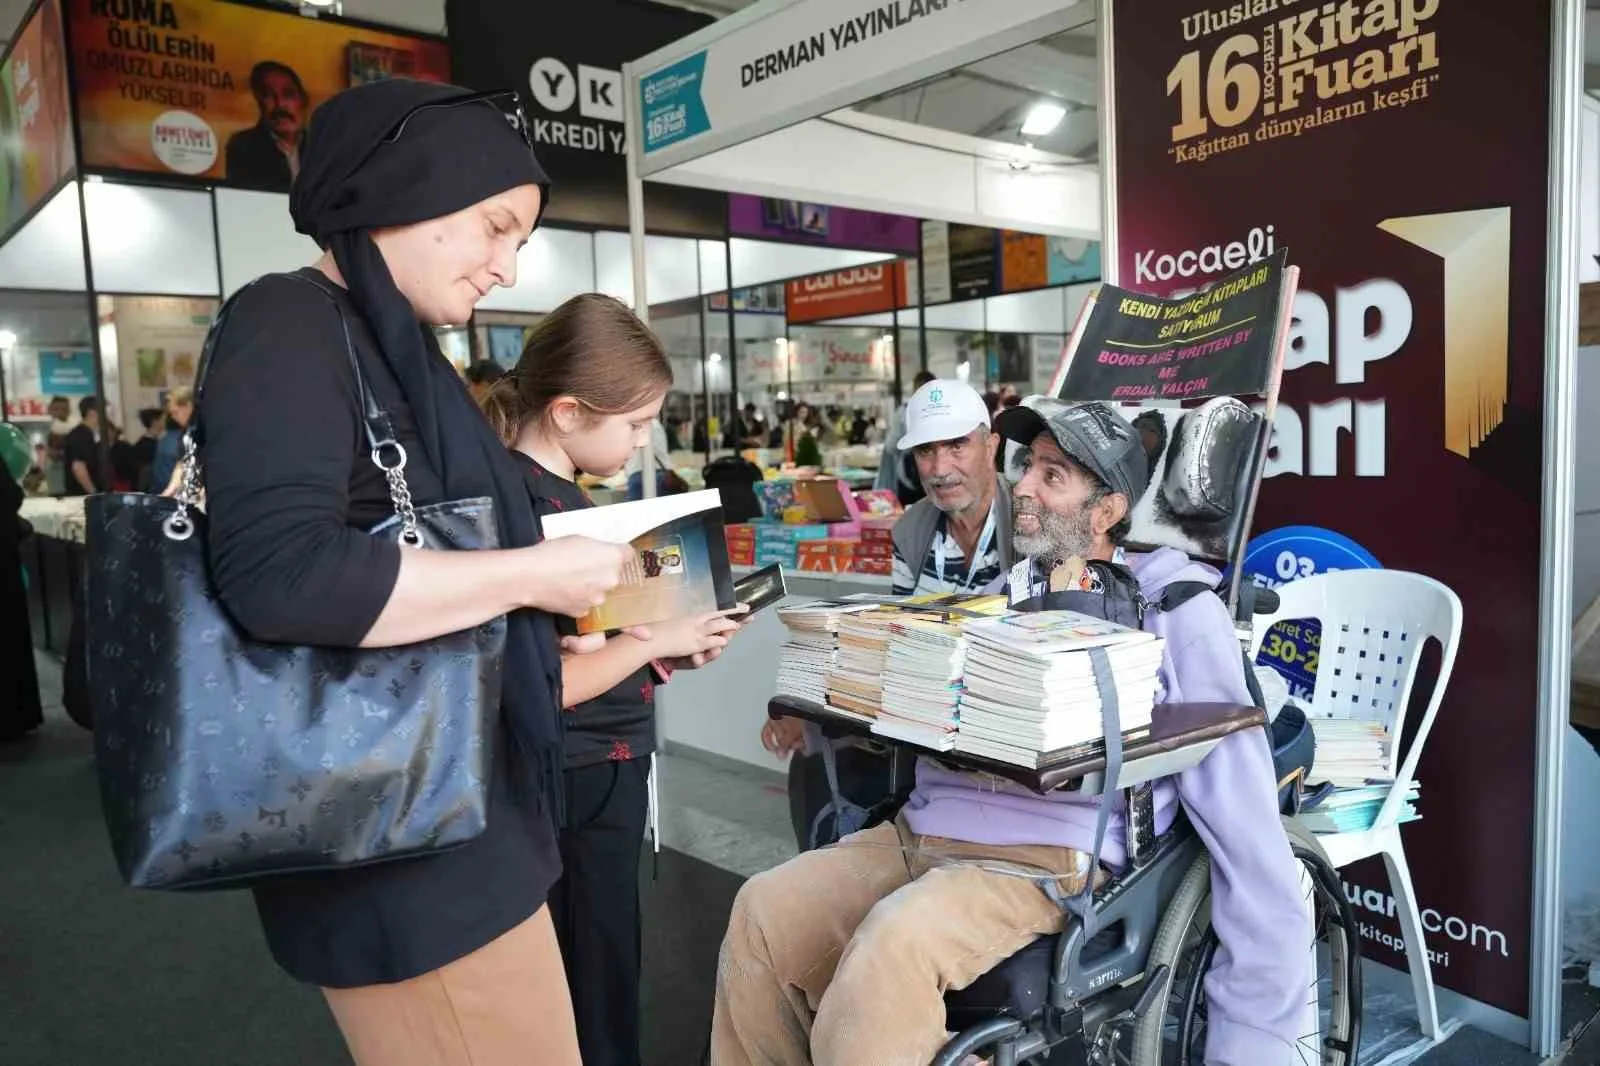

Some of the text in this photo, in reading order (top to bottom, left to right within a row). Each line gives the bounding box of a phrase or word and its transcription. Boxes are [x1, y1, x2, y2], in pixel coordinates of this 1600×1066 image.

[107, 20, 215, 63] ÖLÜLERİN
[1279, 0, 1440, 64] Kitap
[86, 51, 234, 90] OMUZLARINDA
[741, 32, 825, 88] DERMAN
[1279, 32, 1440, 112] Fuarı
[541, 70, 565, 97] Y
[590, 79, 614, 107] K
[534, 118, 604, 152] KREDİ
[1256, 99, 1366, 141] dünyaların
[1135, 225, 1275, 284] Kocaeli
[1118, 297, 1163, 320] KENDİ
[1097, 328, 1254, 366] BOOKS ARE WRITTEN BY
[1112, 377, 1209, 397] ERDAL YALÇIN
[1158, 365, 1180, 379] ME
